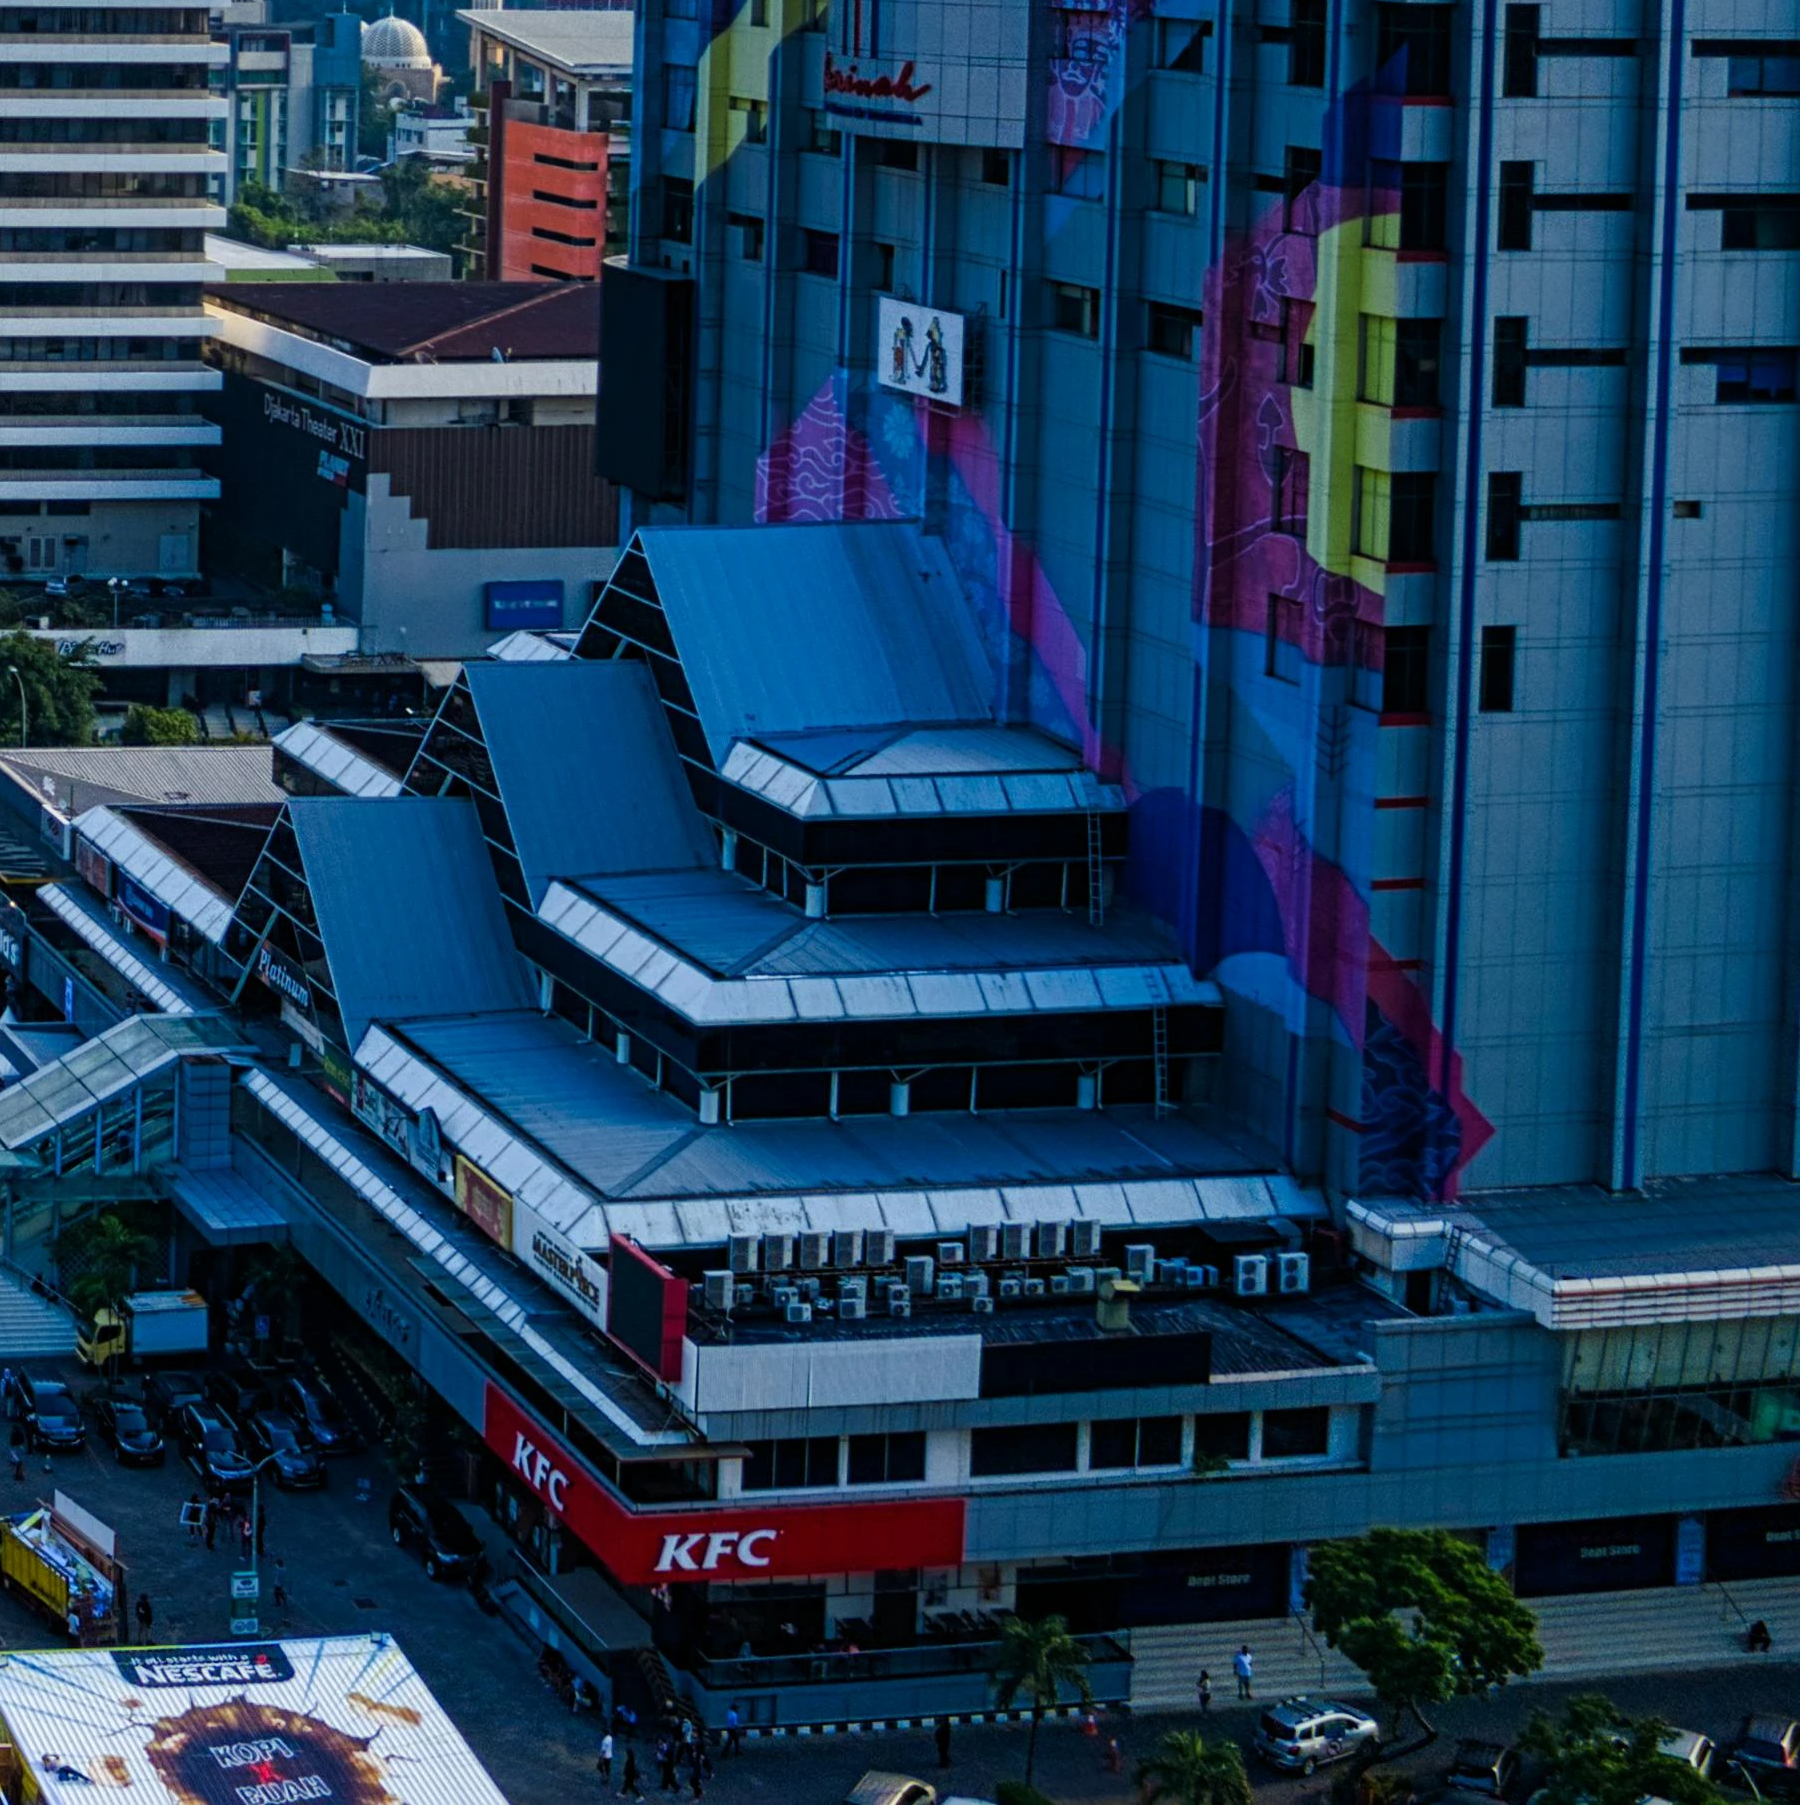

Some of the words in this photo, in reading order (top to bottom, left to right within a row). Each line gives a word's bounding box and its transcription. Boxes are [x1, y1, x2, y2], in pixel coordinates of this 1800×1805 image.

[263, 392, 301, 429] Djakarta
[300, 406, 338, 444] Theater
[338, 420, 367, 461] XXI
[258, 948, 309, 1007] Platinum
[512, 1431, 570, 1512] KFC
[653, 1529, 778, 1573] KFC
[209, 1737, 294, 1768] KOPI
[235, 1775, 332, 1805] BUAH
